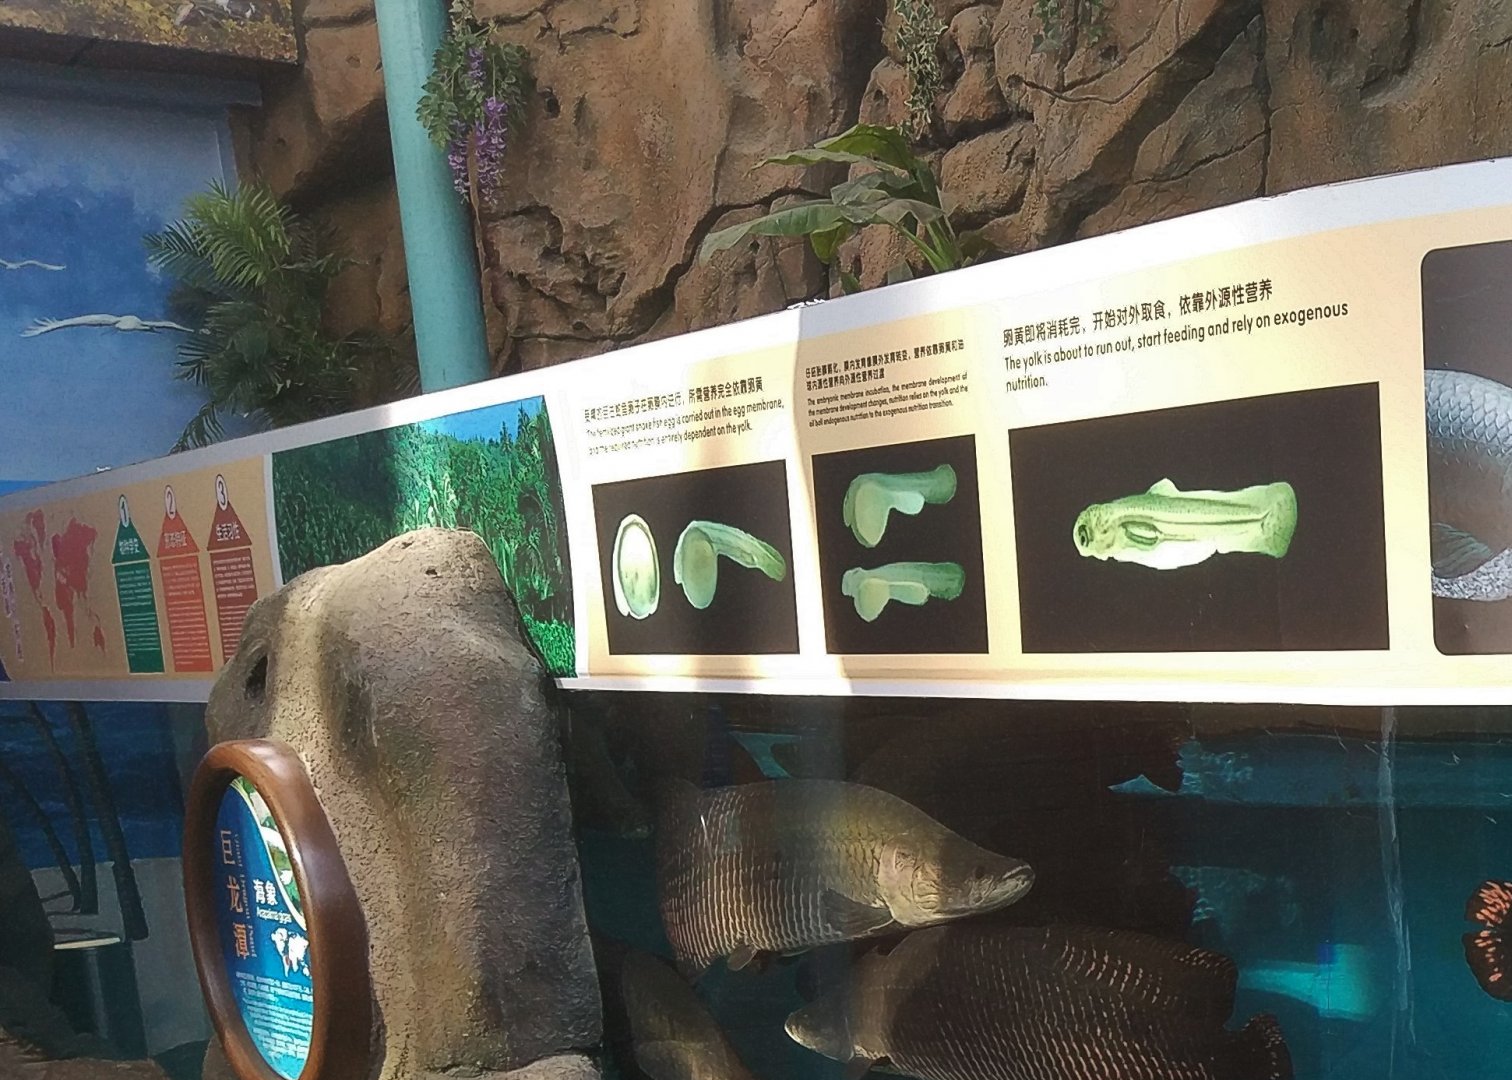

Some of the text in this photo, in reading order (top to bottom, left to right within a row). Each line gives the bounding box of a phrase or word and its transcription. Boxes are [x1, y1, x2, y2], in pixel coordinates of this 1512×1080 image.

[1004, 302, 1349, 373] The yolk is about to run out, start feeding and rely on exogenous
[840, 389, 864, 401] membrane
[892, 383, 900, 392] the
[901, 379, 927, 391] membrane
[928, 373, 961, 387] development
[1006, 374, 1048, 393] nutrition.
[682, 409, 703, 423] carried
[703, 408, 715, 420] out
[715, 407, 721, 418] in
[721, 405, 733, 417] the
[732, 404, 746, 418] egg
[746, 399, 785, 414] membrane,
[684, 426, 716, 442] dependent
[717, 427, 725, 437] on
[725, 423, 736, 435] the
[737, 421, 753, 435] yolk.
[167, 490, 174, 515] 2
[218, 481, 226, 505] 3
